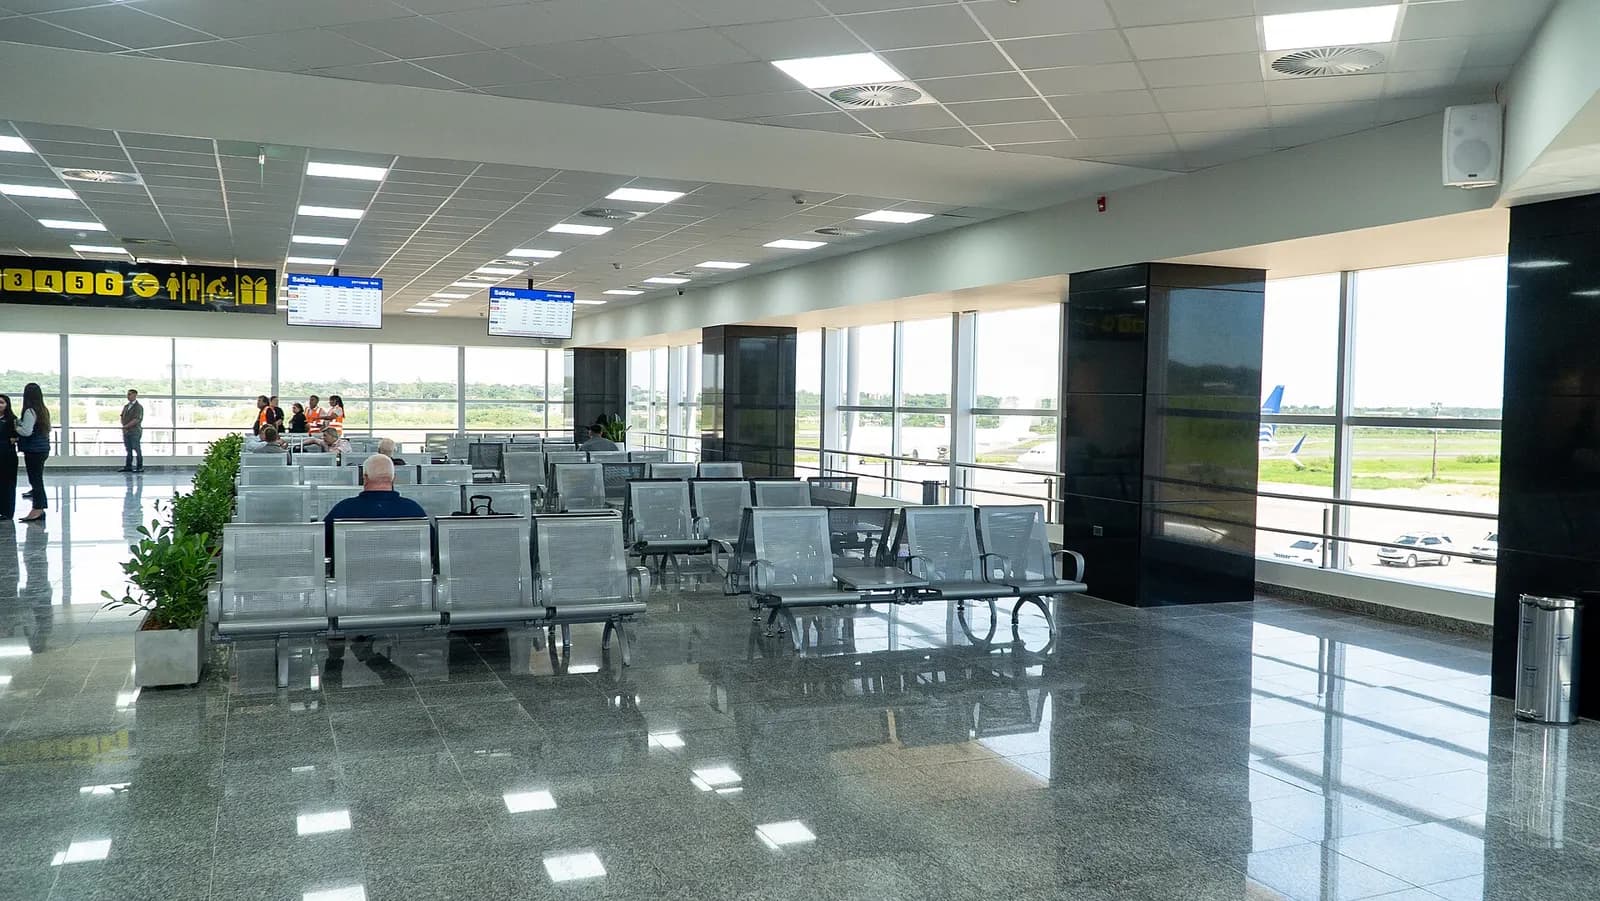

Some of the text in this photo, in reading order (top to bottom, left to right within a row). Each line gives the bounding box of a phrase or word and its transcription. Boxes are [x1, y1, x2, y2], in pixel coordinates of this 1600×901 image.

[14, 273, 114, 290] 3 4 5 6
[494, 289, 515, 297] Salidas
